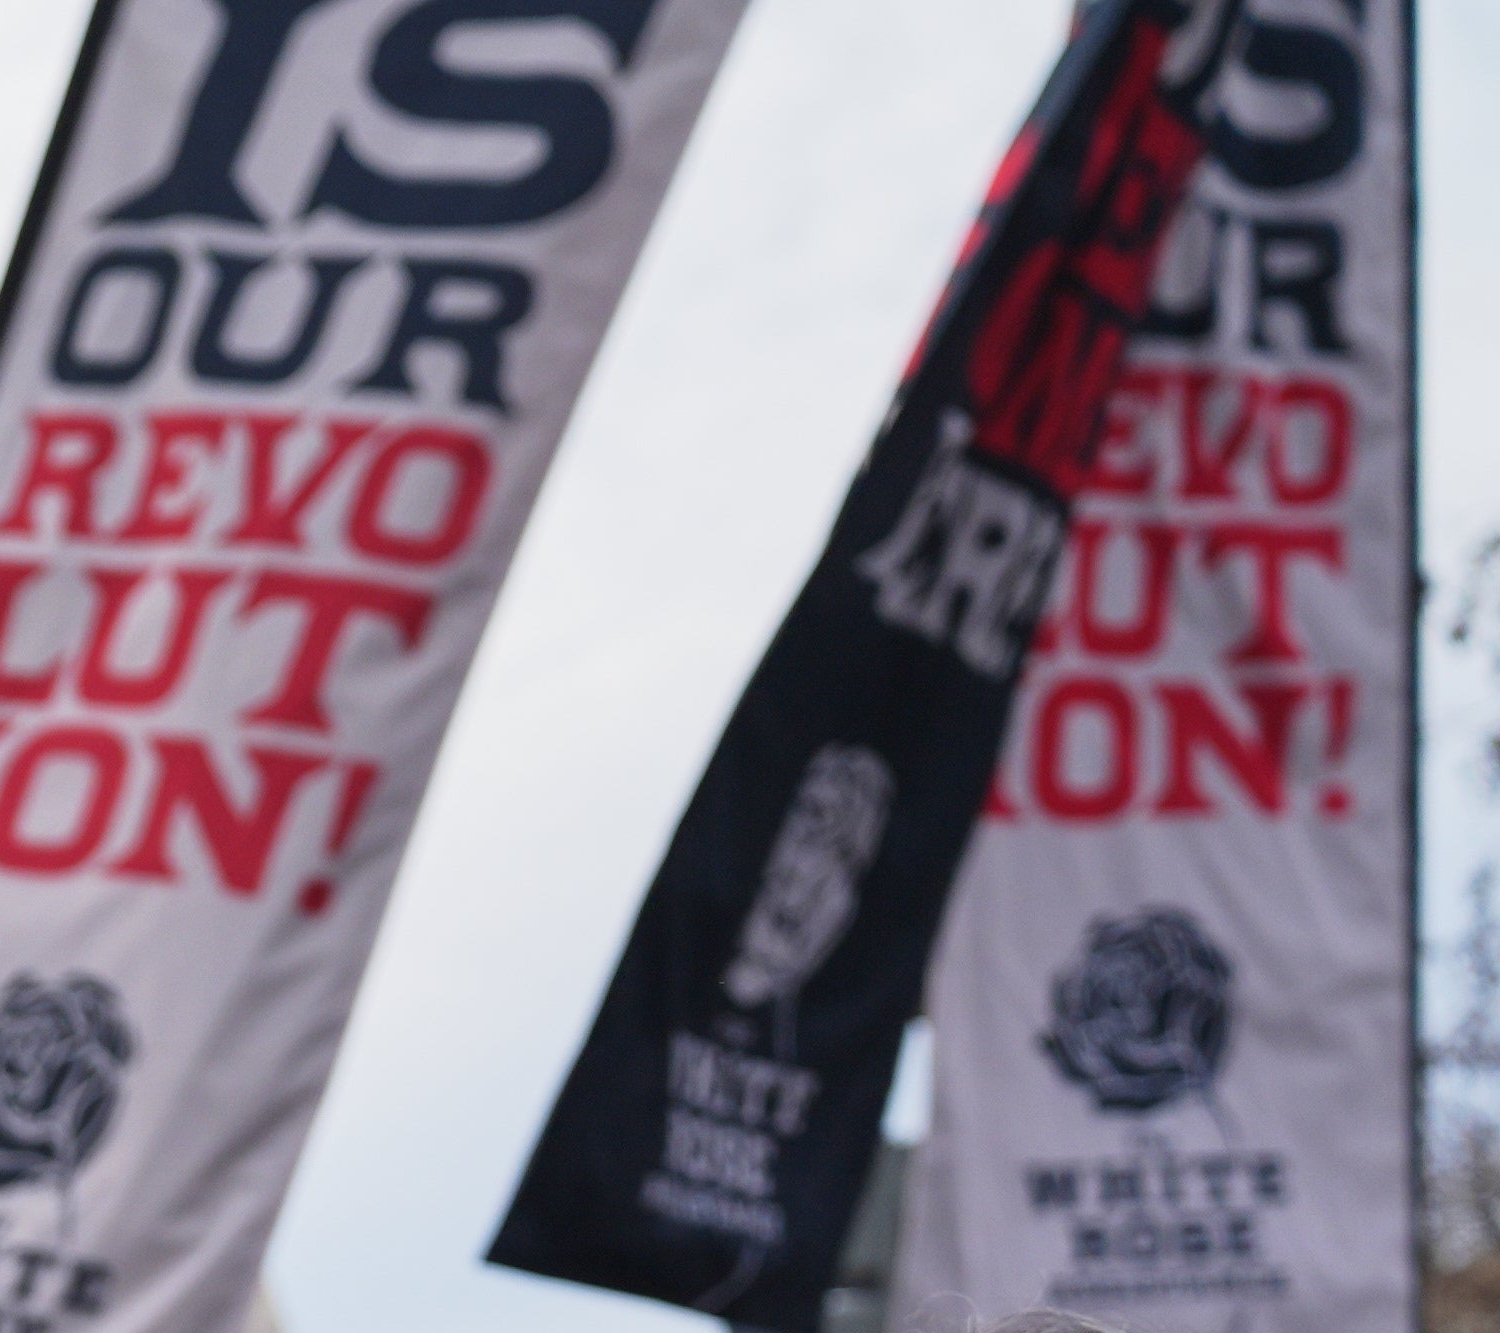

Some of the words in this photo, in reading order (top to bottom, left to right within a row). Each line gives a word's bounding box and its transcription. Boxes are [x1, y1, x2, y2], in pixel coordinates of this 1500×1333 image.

[98, 0, 656, 232] IS
[48, 246, 537, 420] OUR
[1095, 366, 1352, 506] EVO
[1040, 518, 1348, 664] UT
[987, 676, 1354, 824] ON!
